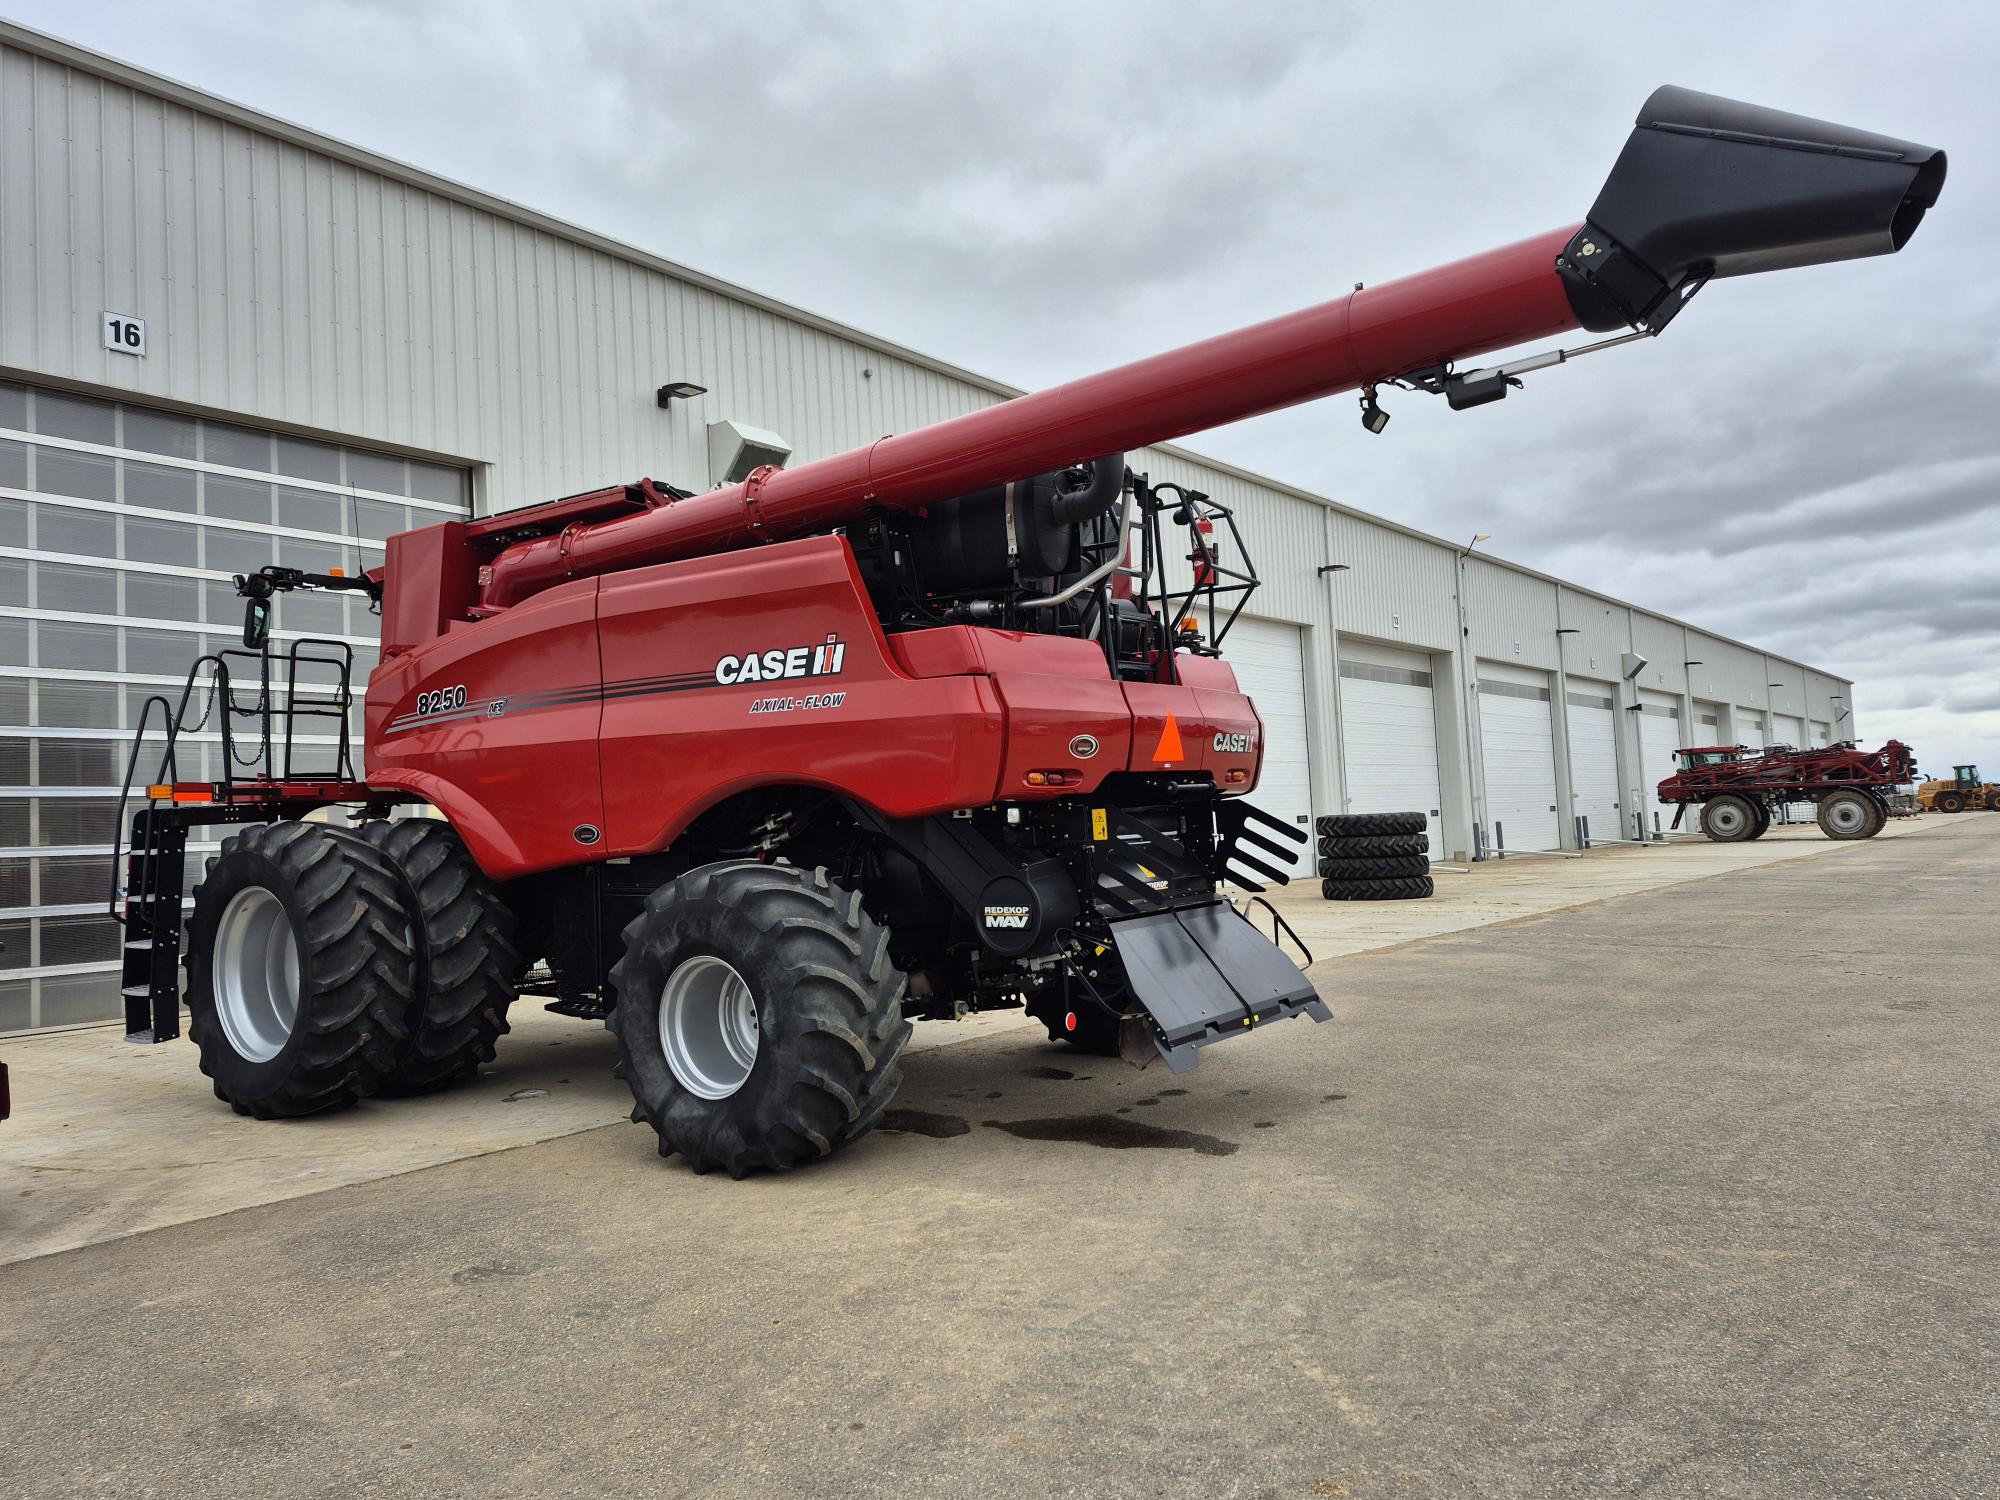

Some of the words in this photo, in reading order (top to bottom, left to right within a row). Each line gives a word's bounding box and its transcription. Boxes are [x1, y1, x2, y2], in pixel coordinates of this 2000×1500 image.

[109, 320, 140, 347] 16
[715, 647, 809, 684] CASE
[417, 684, 467, 716] 8250
[749, 692, 846, 714] AXIAL-FLOW
[1213, 732, 1246, 752] CASE
[984, 906, 1030, 914] REDEKOP
[985, 916, 1029, 928] MAV
